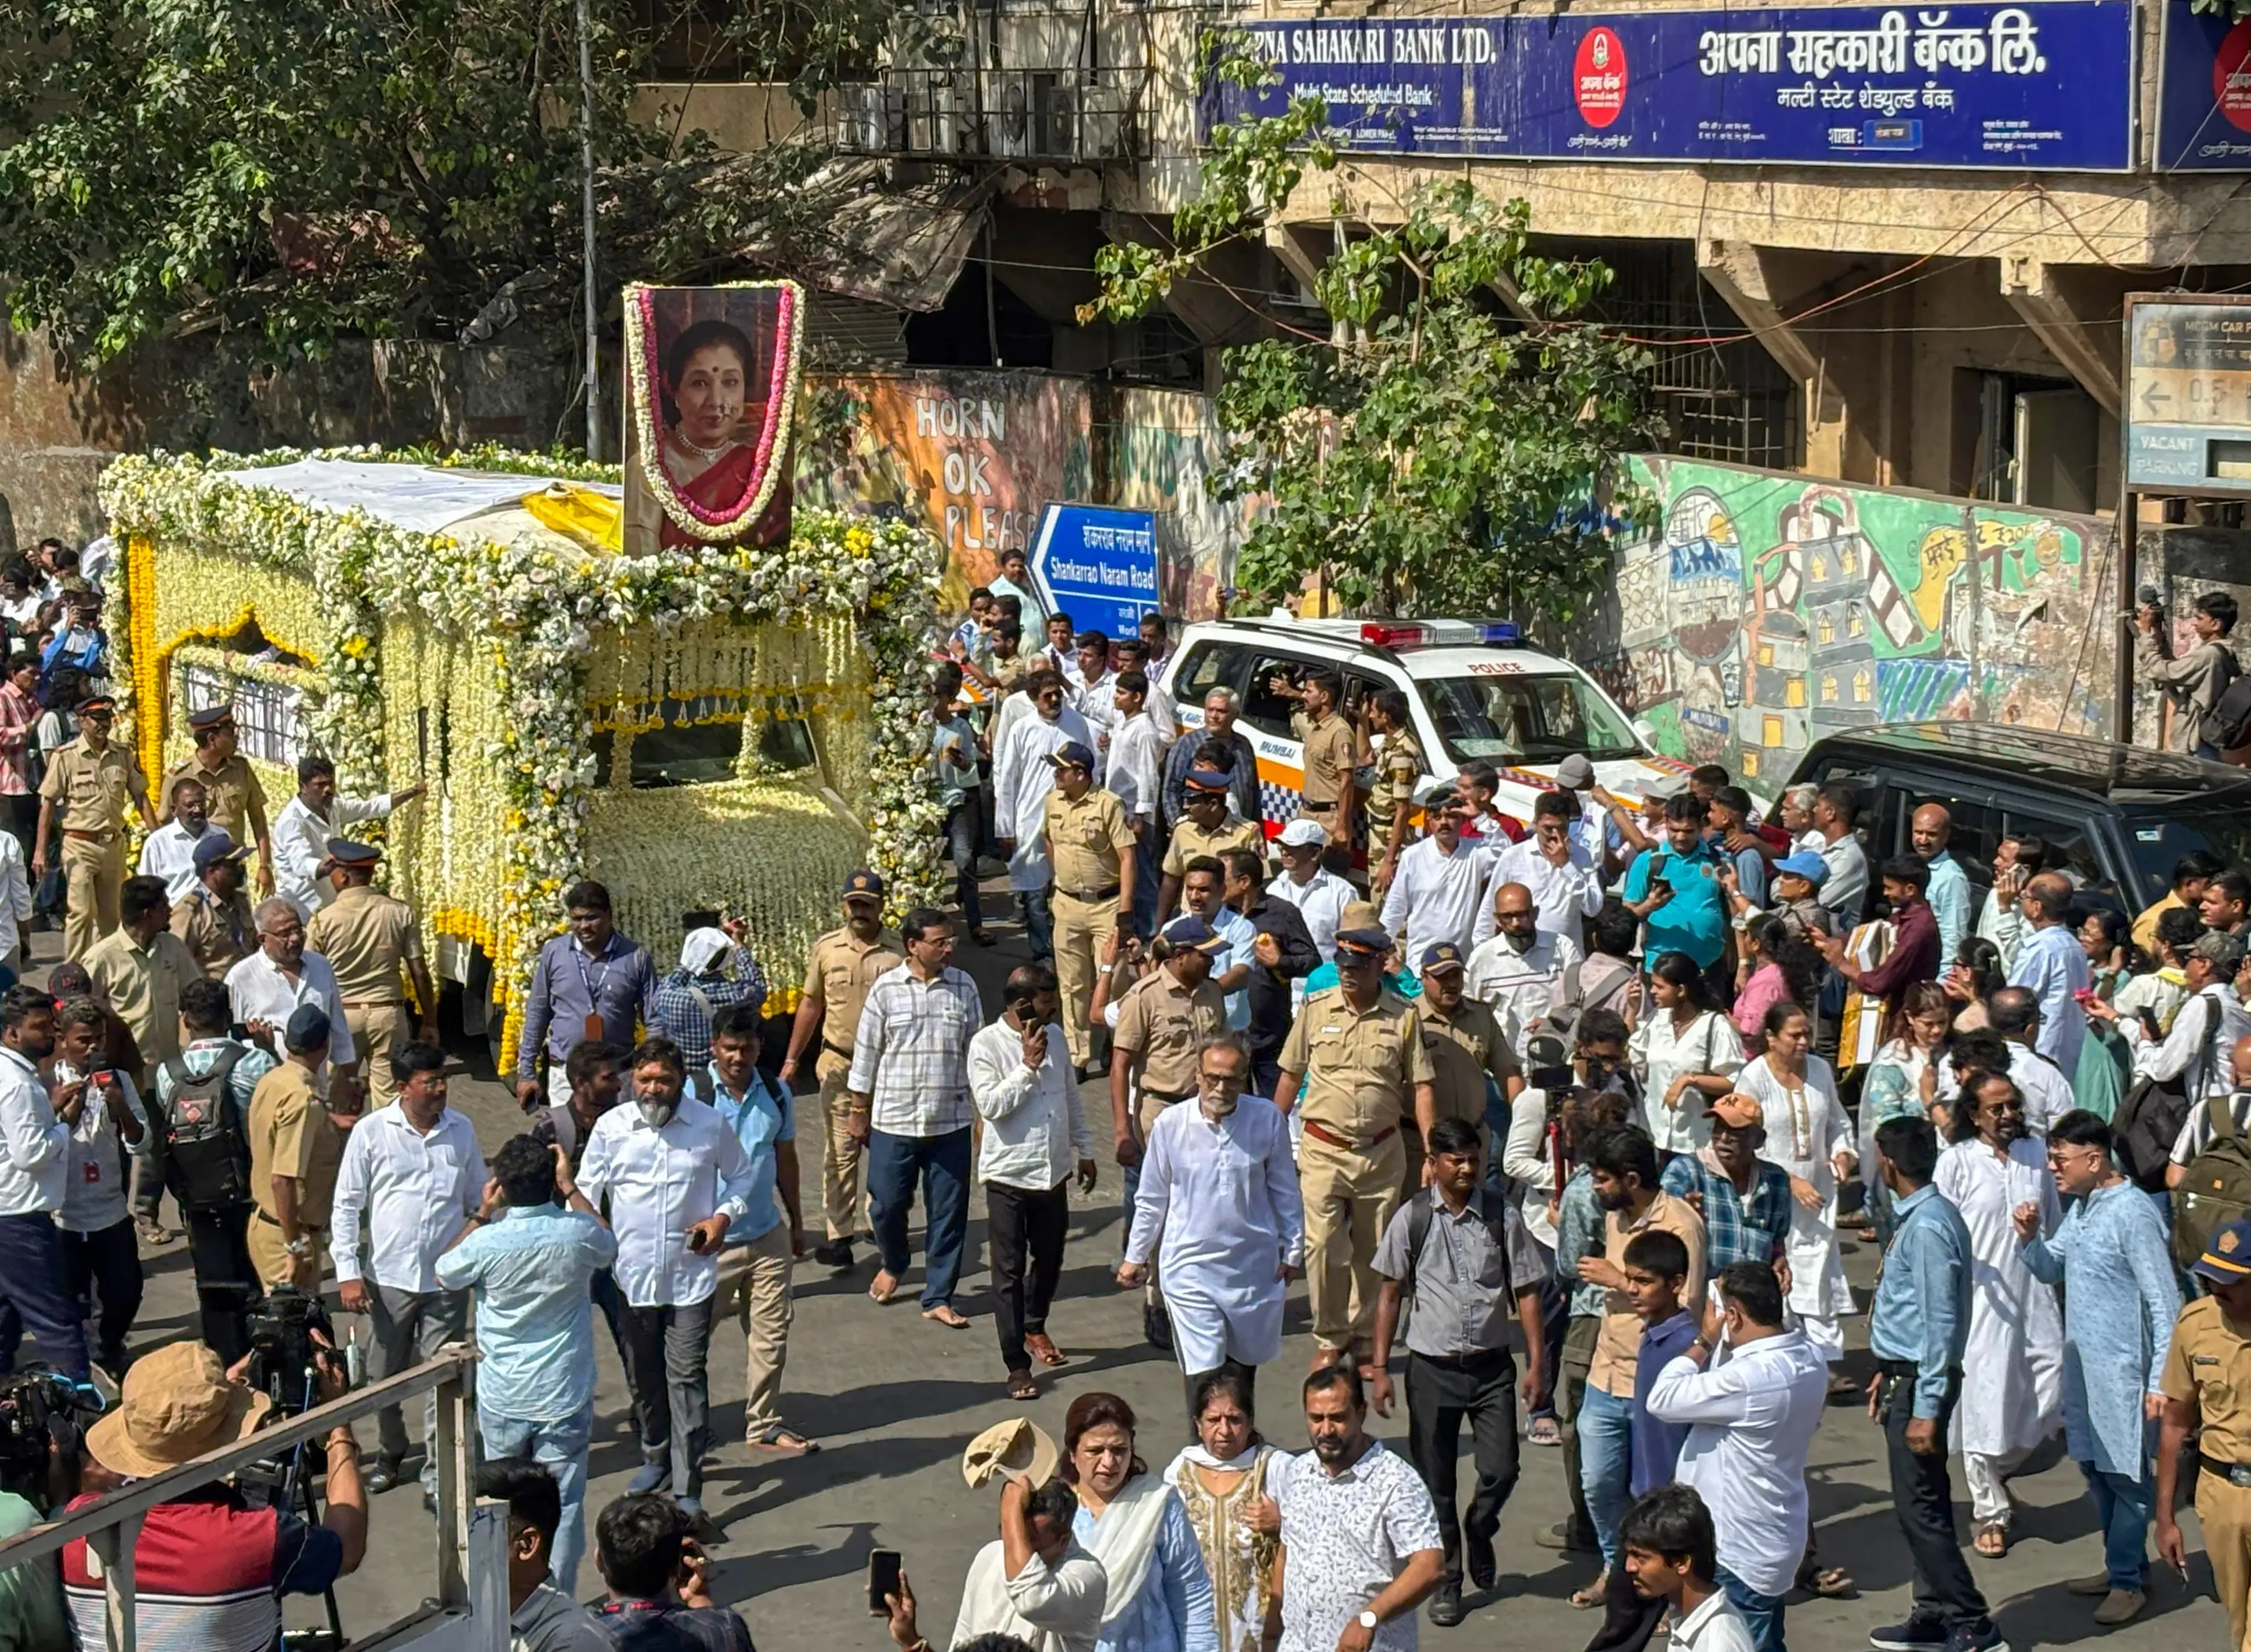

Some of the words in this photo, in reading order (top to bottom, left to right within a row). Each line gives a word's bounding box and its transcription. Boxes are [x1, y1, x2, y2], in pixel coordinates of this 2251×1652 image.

[1292, 28, 1386, 64] SAHAKARI
[1394, 28, 1445, 64] BANK
[1451, 27, 1498, 64] LTD.
[1699, 31, 1783, 76] अपना
[1786, 10, 1911, 79] सहकारी
[1988, 8, 2047, 74] लि.
[1322, 82, 1349, 103] State
[1350, 83, 1402, 104] Scheduled
[1405, 83, 1433, 106] Bank
[1777, 81, 1817, 108] मल्टी
[1819, 81, 1855, 109] स्टेट
[2221, 321, 2243, 333] CAR
[916, 397, 1005, 441] HORN
[2140, 435, 2195, 451] VACANT
[944, 453, 992, 496] OK
[1050, 556, 1098, 584] Shankarrao
[1099, 561, 1129, 587] Naram
[1130, 564, 1155, 590] Road
[1466, 662, 1526, 674] POLICE
[1259, 740, 1296, 760] MUMBAI
